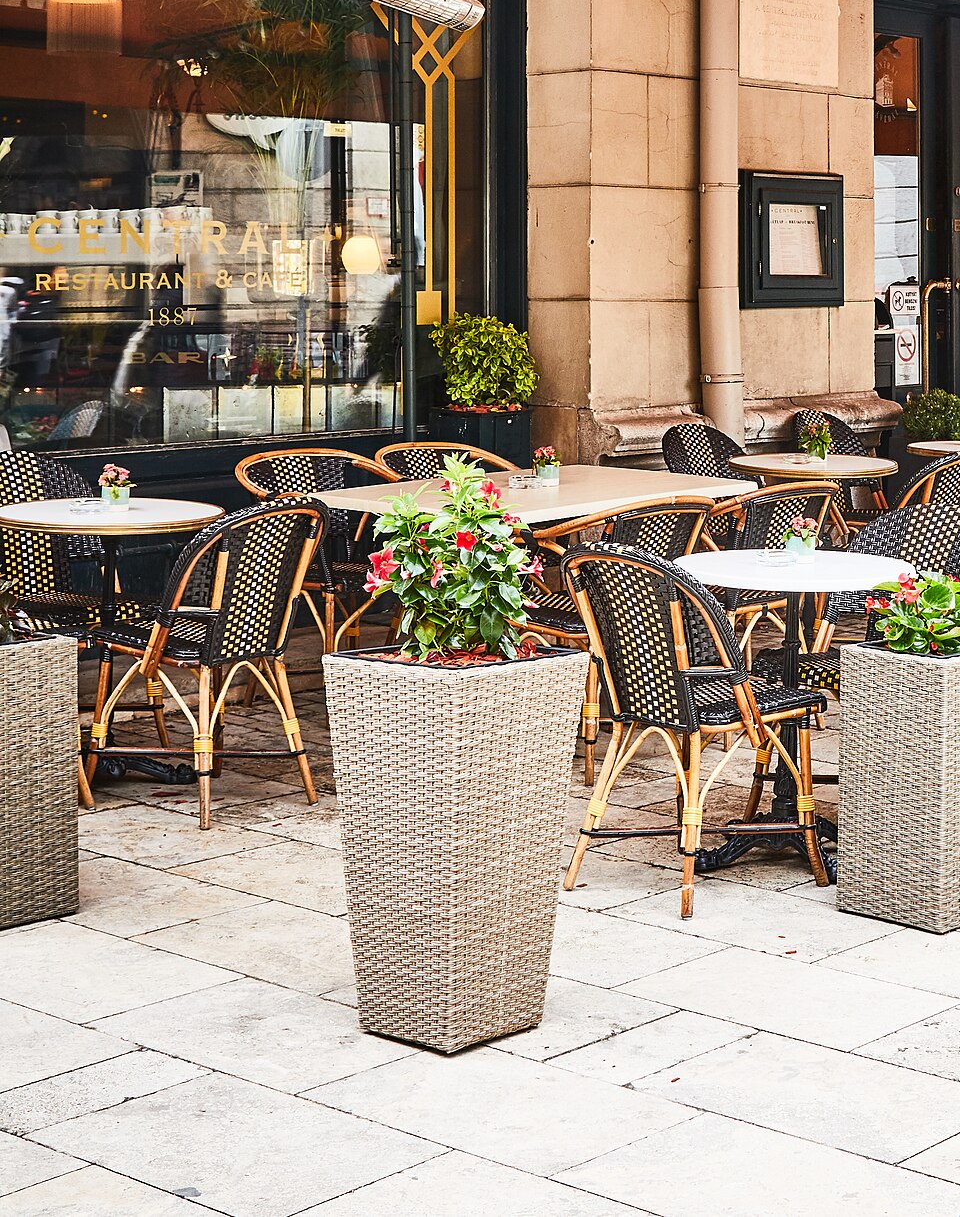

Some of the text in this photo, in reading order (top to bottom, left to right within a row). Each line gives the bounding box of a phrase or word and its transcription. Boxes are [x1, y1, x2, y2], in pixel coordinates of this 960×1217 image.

[28, 216, 303, 255] CENTRAL
[35, 267, 303, 291] RESTAURANT & CAÉ
[149, 307, 198, 327] 1887
[129, 352, 204, 365] BAR
